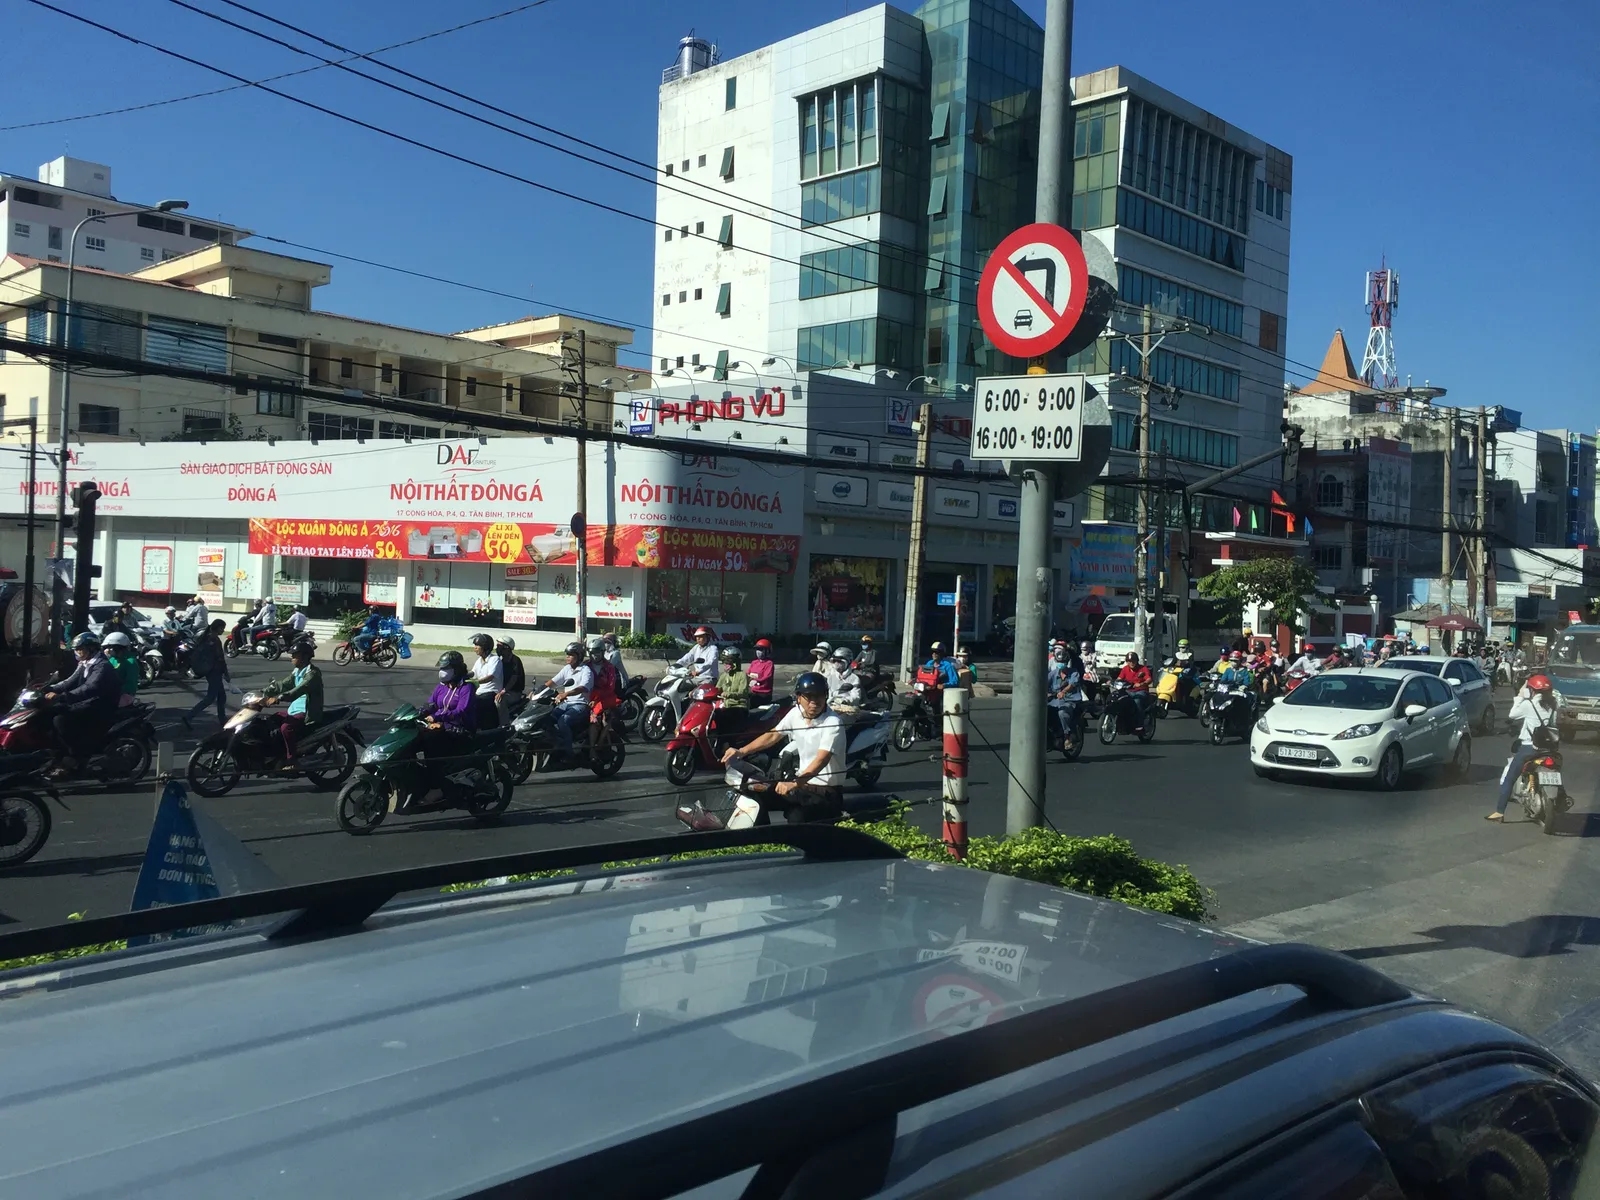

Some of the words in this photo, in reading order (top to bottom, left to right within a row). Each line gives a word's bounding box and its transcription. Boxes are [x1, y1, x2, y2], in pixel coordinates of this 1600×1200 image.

[658, 396, 745, 426] PHONG
[985, 389, 1021, 413] 6:00
[1038, 386, 1076, 412] 9:00
[976, 426, 1018, 450] 16:00
[1031, 425, 1073, 450] 19:00
[202, 463, 227, 474] GIAO
[228, 463, 252, 477] DỊCH
[291, 546, 316, 556] TRAO
[317, 547, 334, 557] TAY
